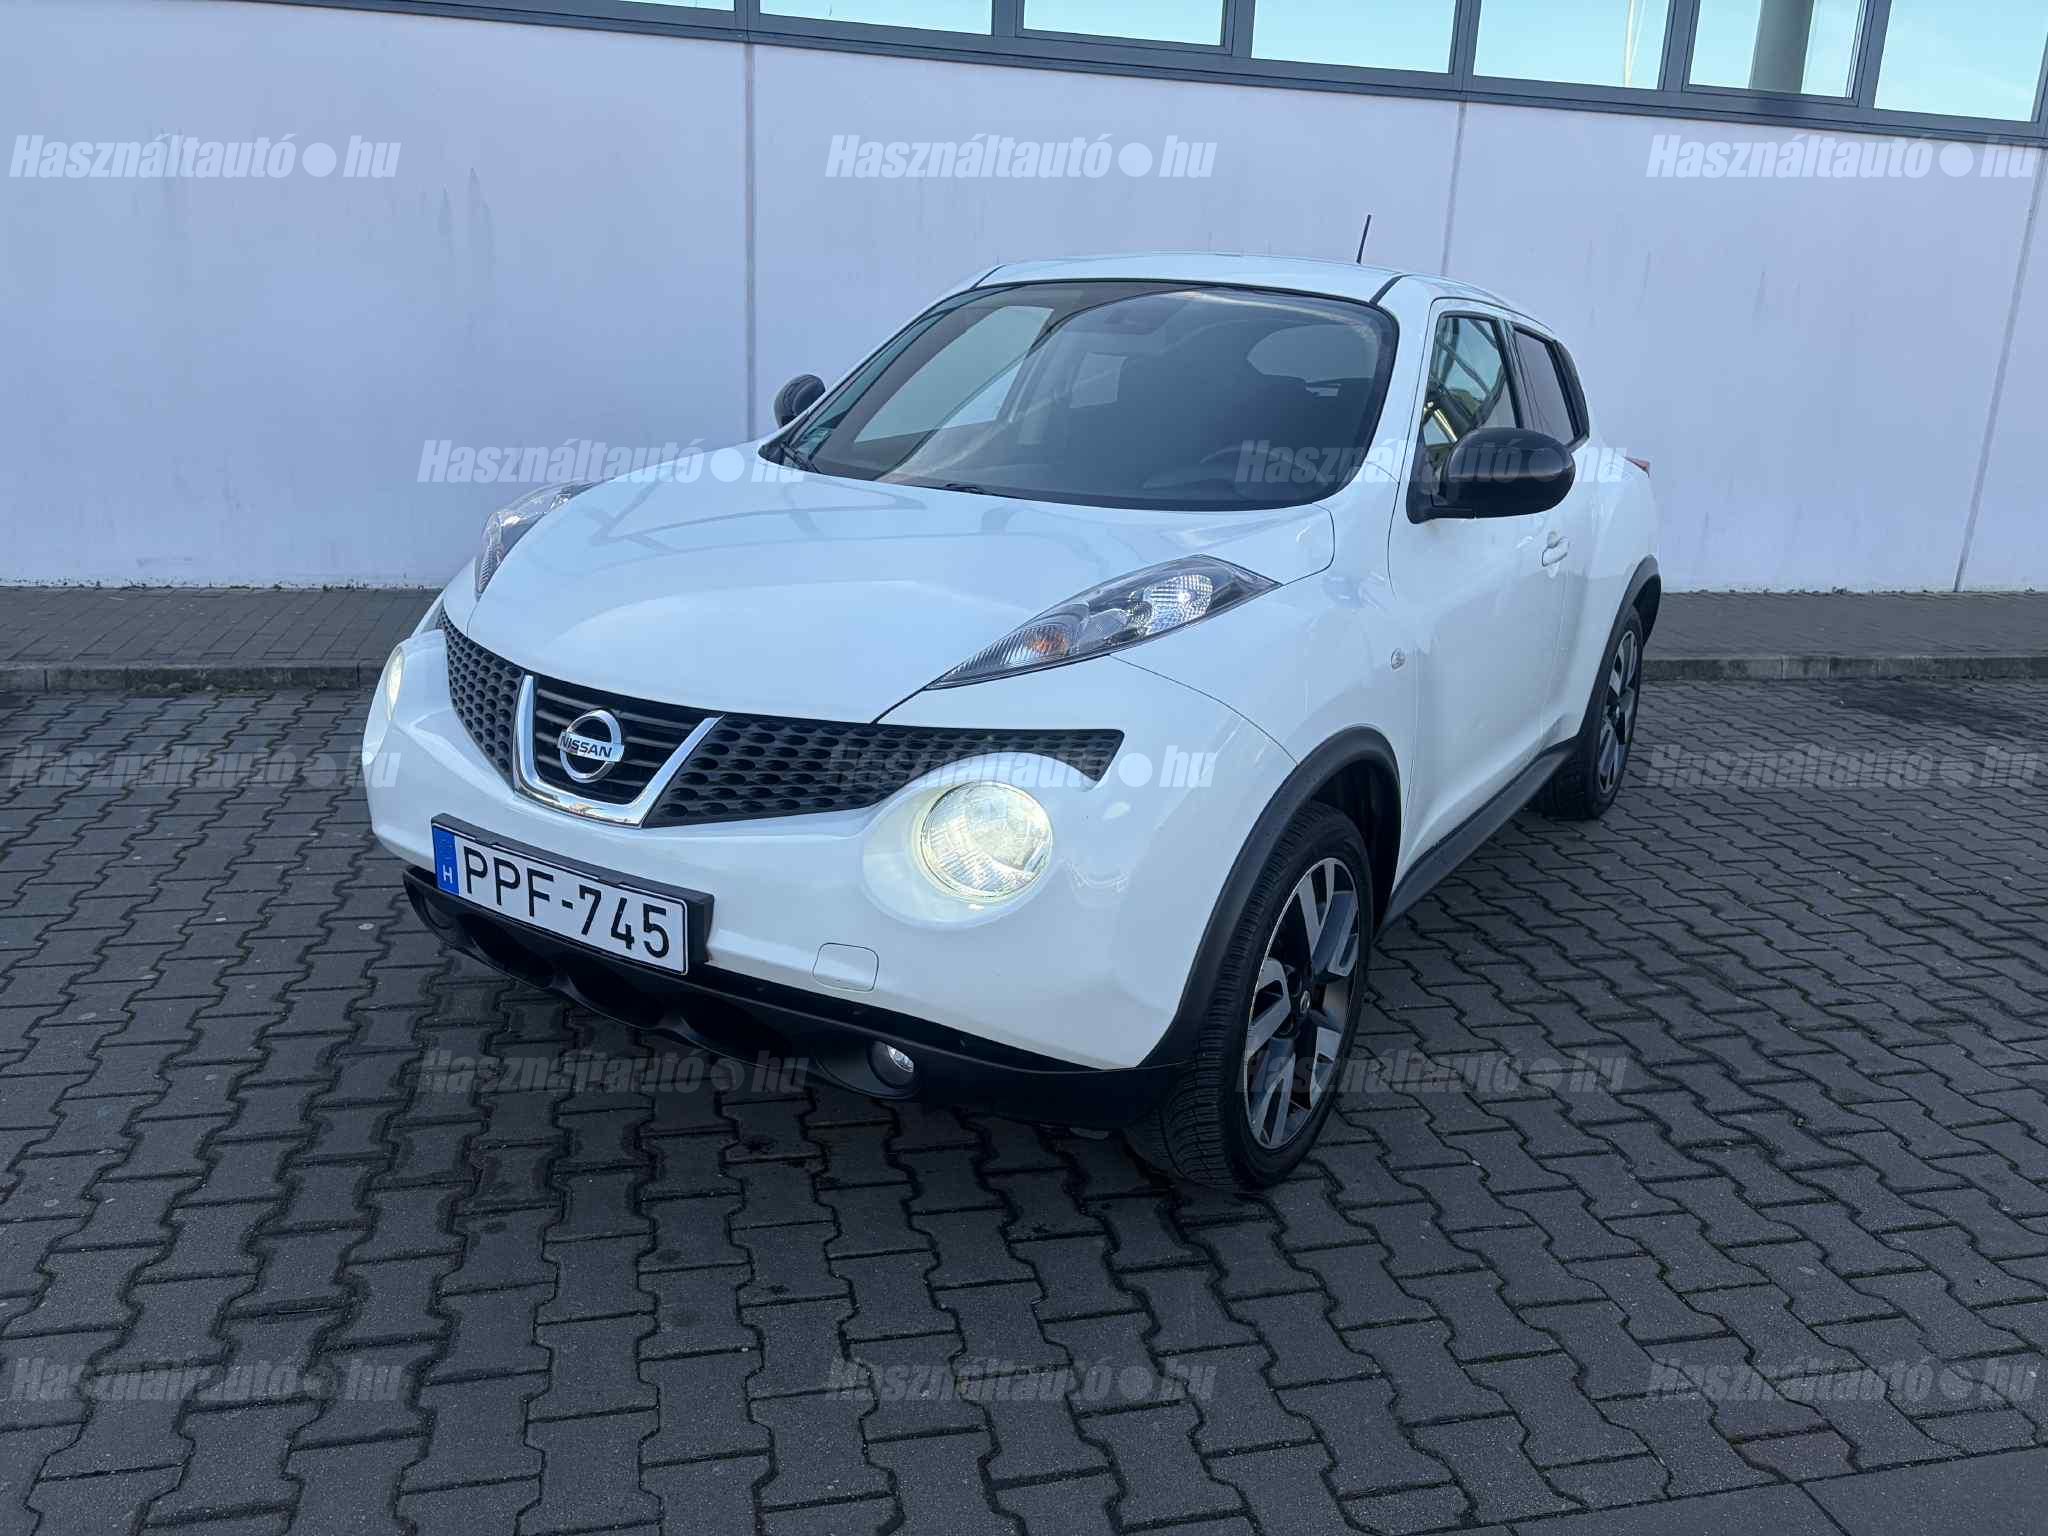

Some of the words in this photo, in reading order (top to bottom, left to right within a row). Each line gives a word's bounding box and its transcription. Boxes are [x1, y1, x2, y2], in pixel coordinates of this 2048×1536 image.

[560, 734, 612, 758] NISSAN
[442, 864, 453, 884] H
[463, 845, 670, 959] PPF-745
